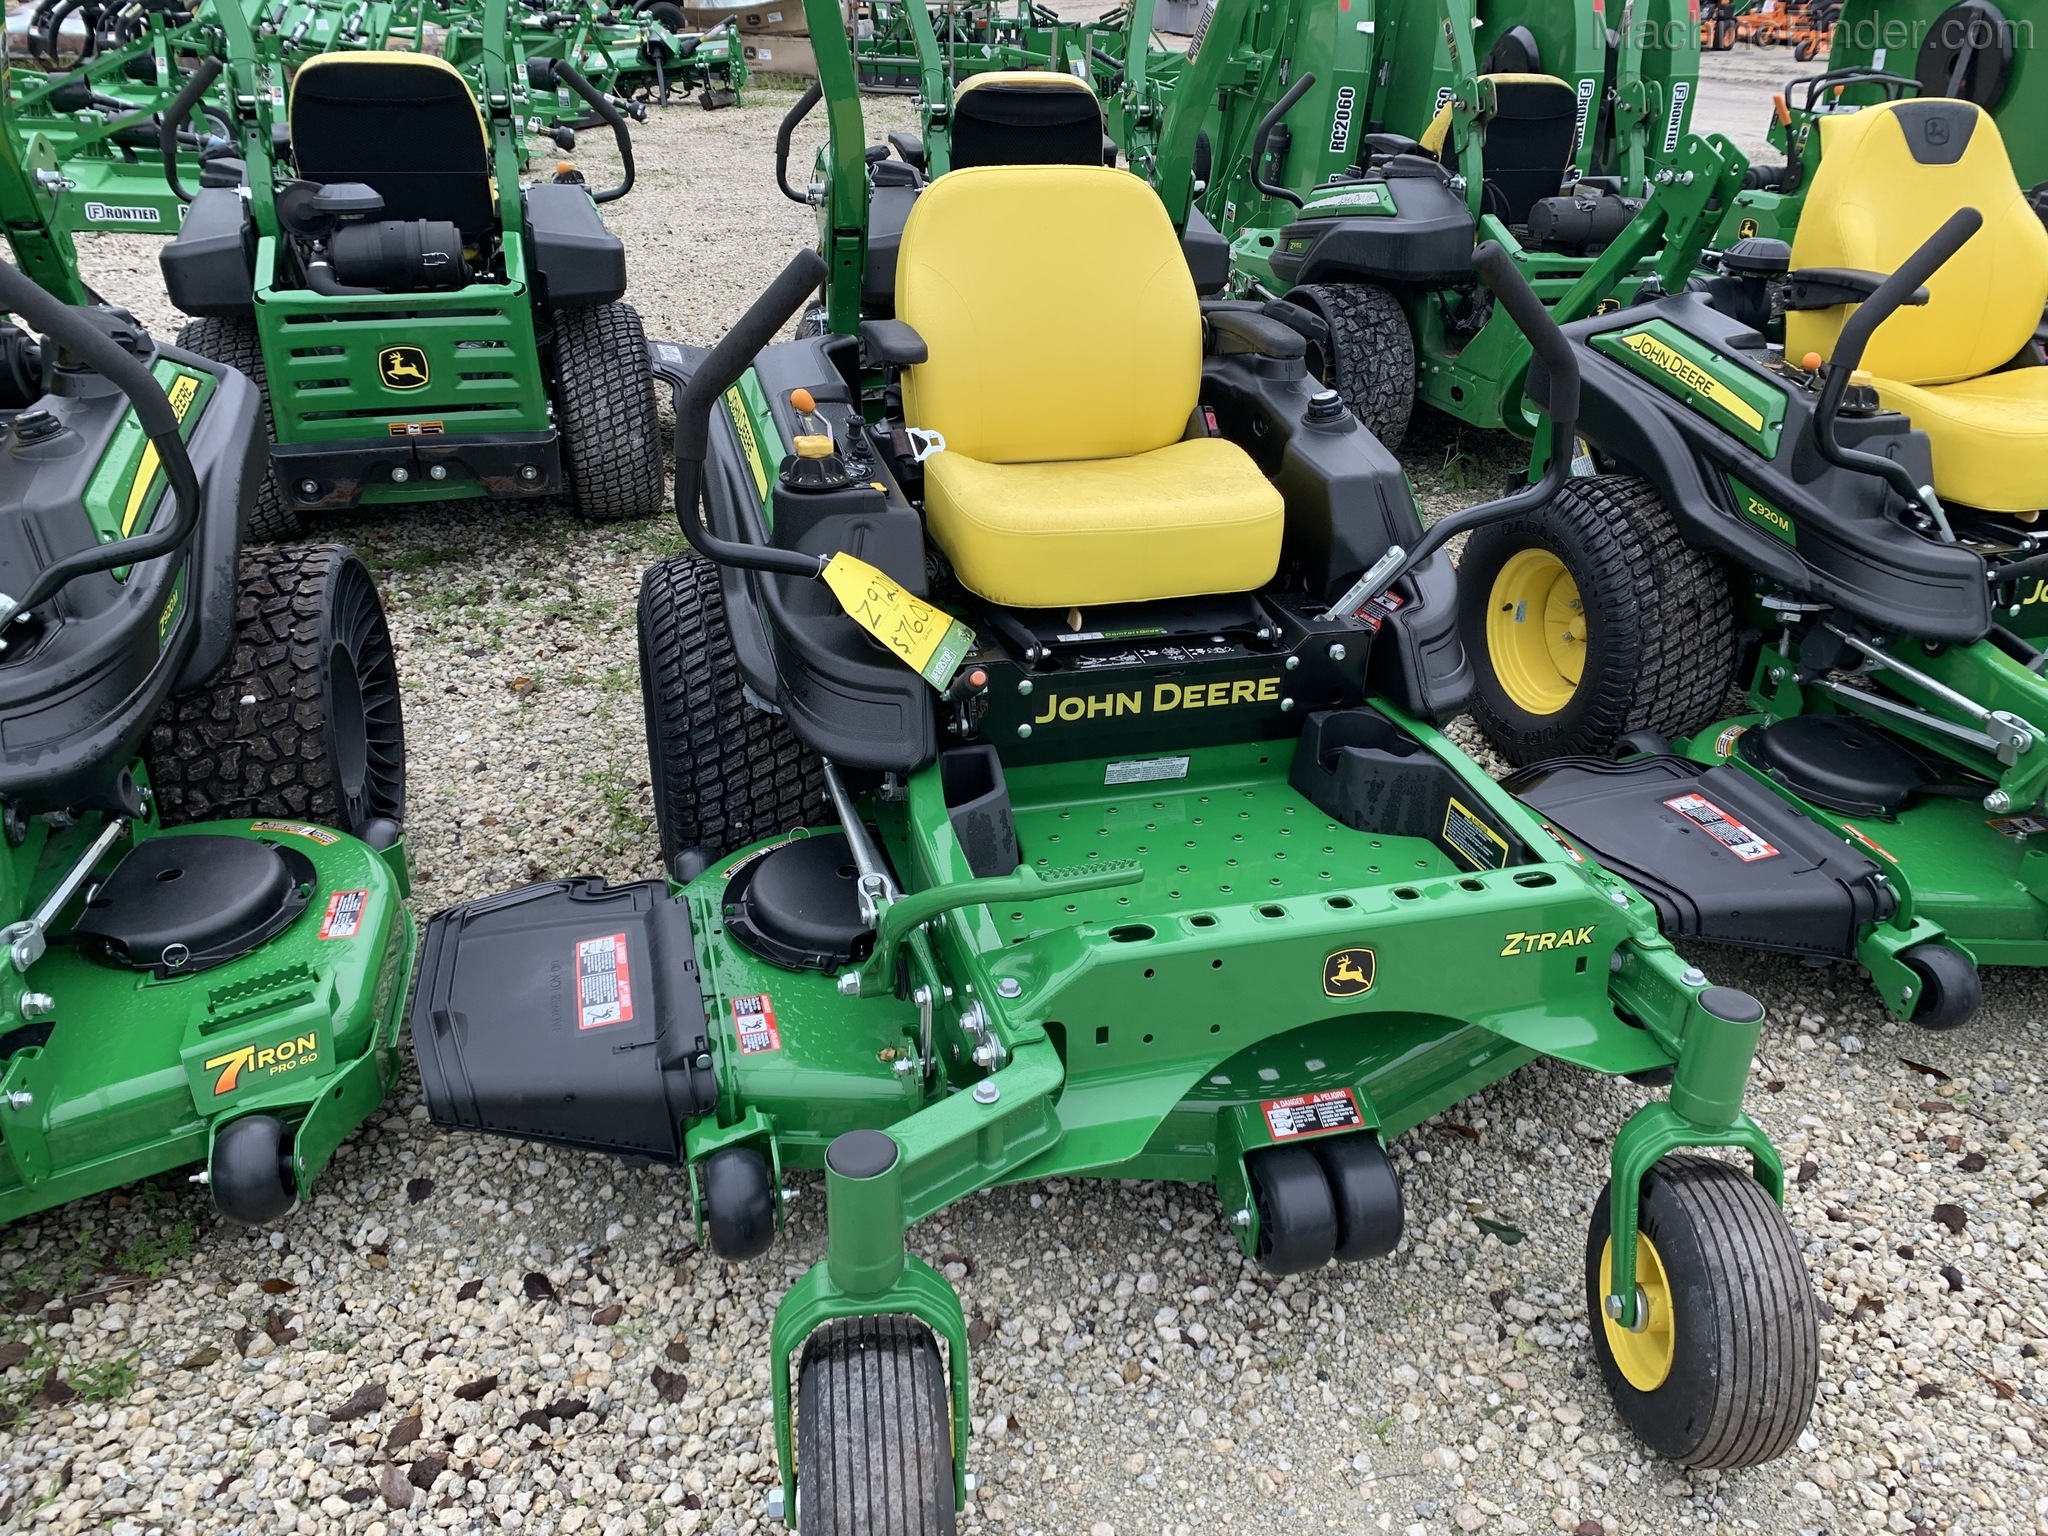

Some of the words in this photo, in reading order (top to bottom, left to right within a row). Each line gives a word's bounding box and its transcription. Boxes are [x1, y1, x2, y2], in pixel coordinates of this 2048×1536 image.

[1330, 87, 1354, 152] RC2060
[1665, 84, 1688, 151] FRONTIER
[87, 203, 159, 220] FRONTIER
[1634, 337, 1667, 367] JOHN
[1669, 355, 1715, 395] DEERE
[1748, 497, 1789, 531] Z920M
[160, 589, 178, 637] Z920M
[1035, 691, 1142, 724] JOHN
[1153, 677, 1281, 712] DEERE
[1500, 925, 1598, 957] ZTRAK
[269, 1060, 297, 1077] PRO
[299, 1052, 318, 1065] 60
[1279, 1097, 1305, 1108] DANGER
[1320, 1090, 1346, 1101] PELIGRO
